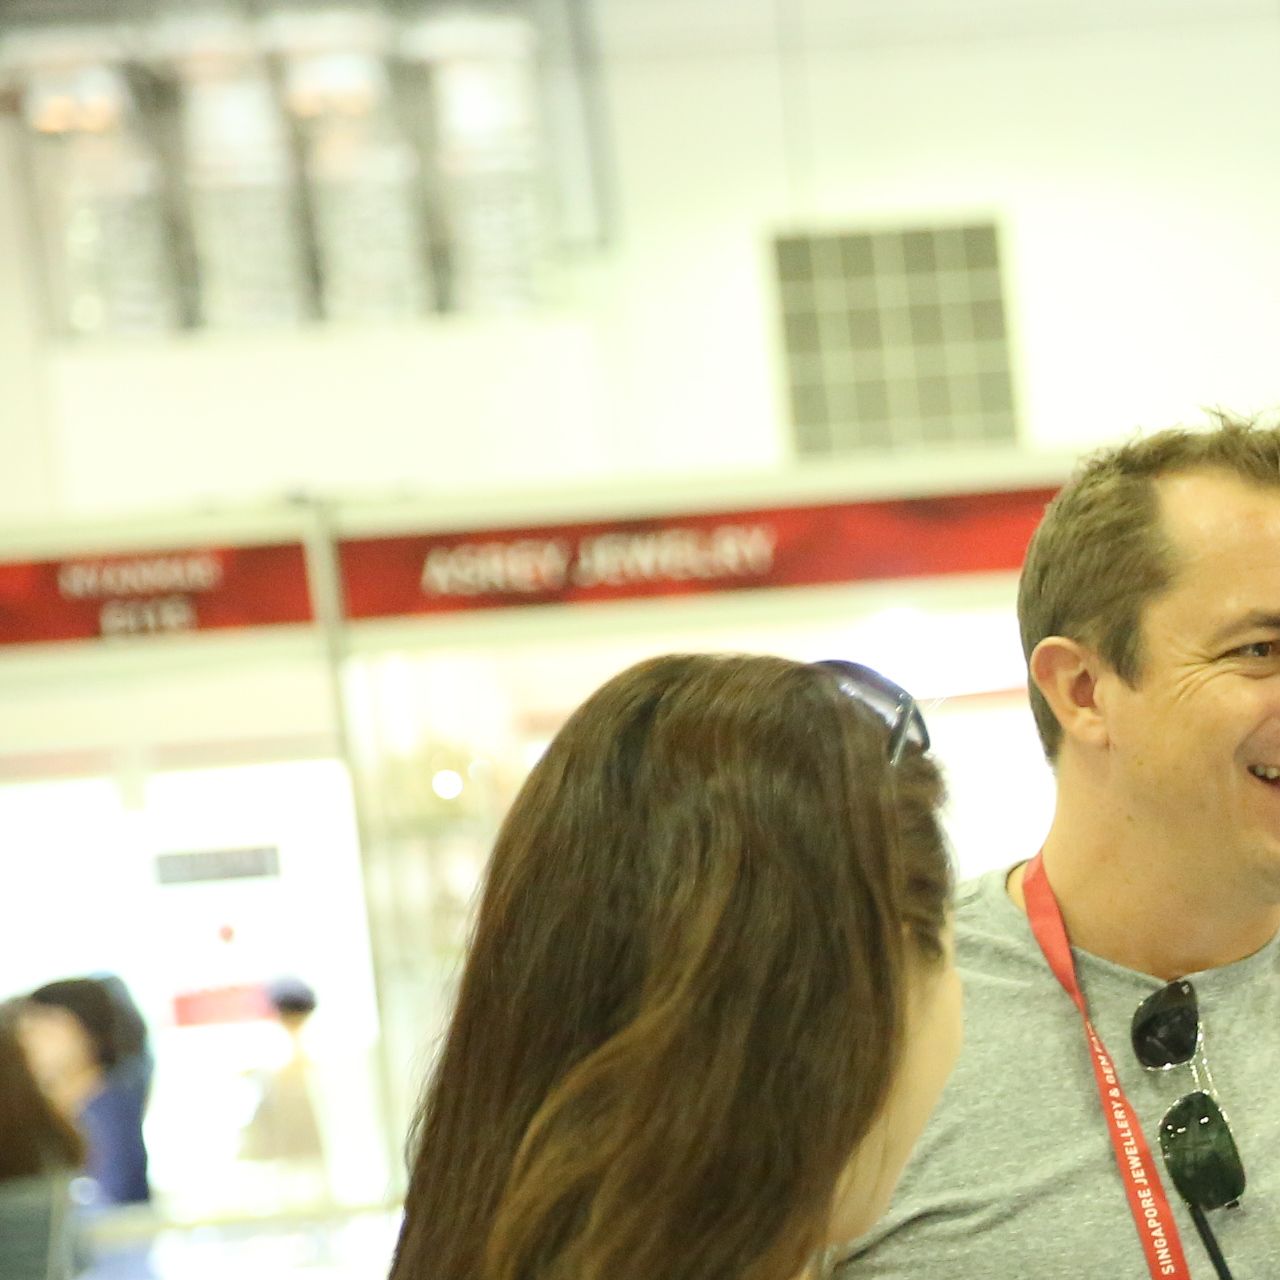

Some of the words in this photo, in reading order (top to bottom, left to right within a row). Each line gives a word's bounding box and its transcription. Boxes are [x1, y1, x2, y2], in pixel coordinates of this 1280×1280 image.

[1108, 1087, 1120, 1098] &
[1111, 1100, 1149, 1186] JEWELLERY
[1137, 1187, 1176, 1276] SINGAPORE
